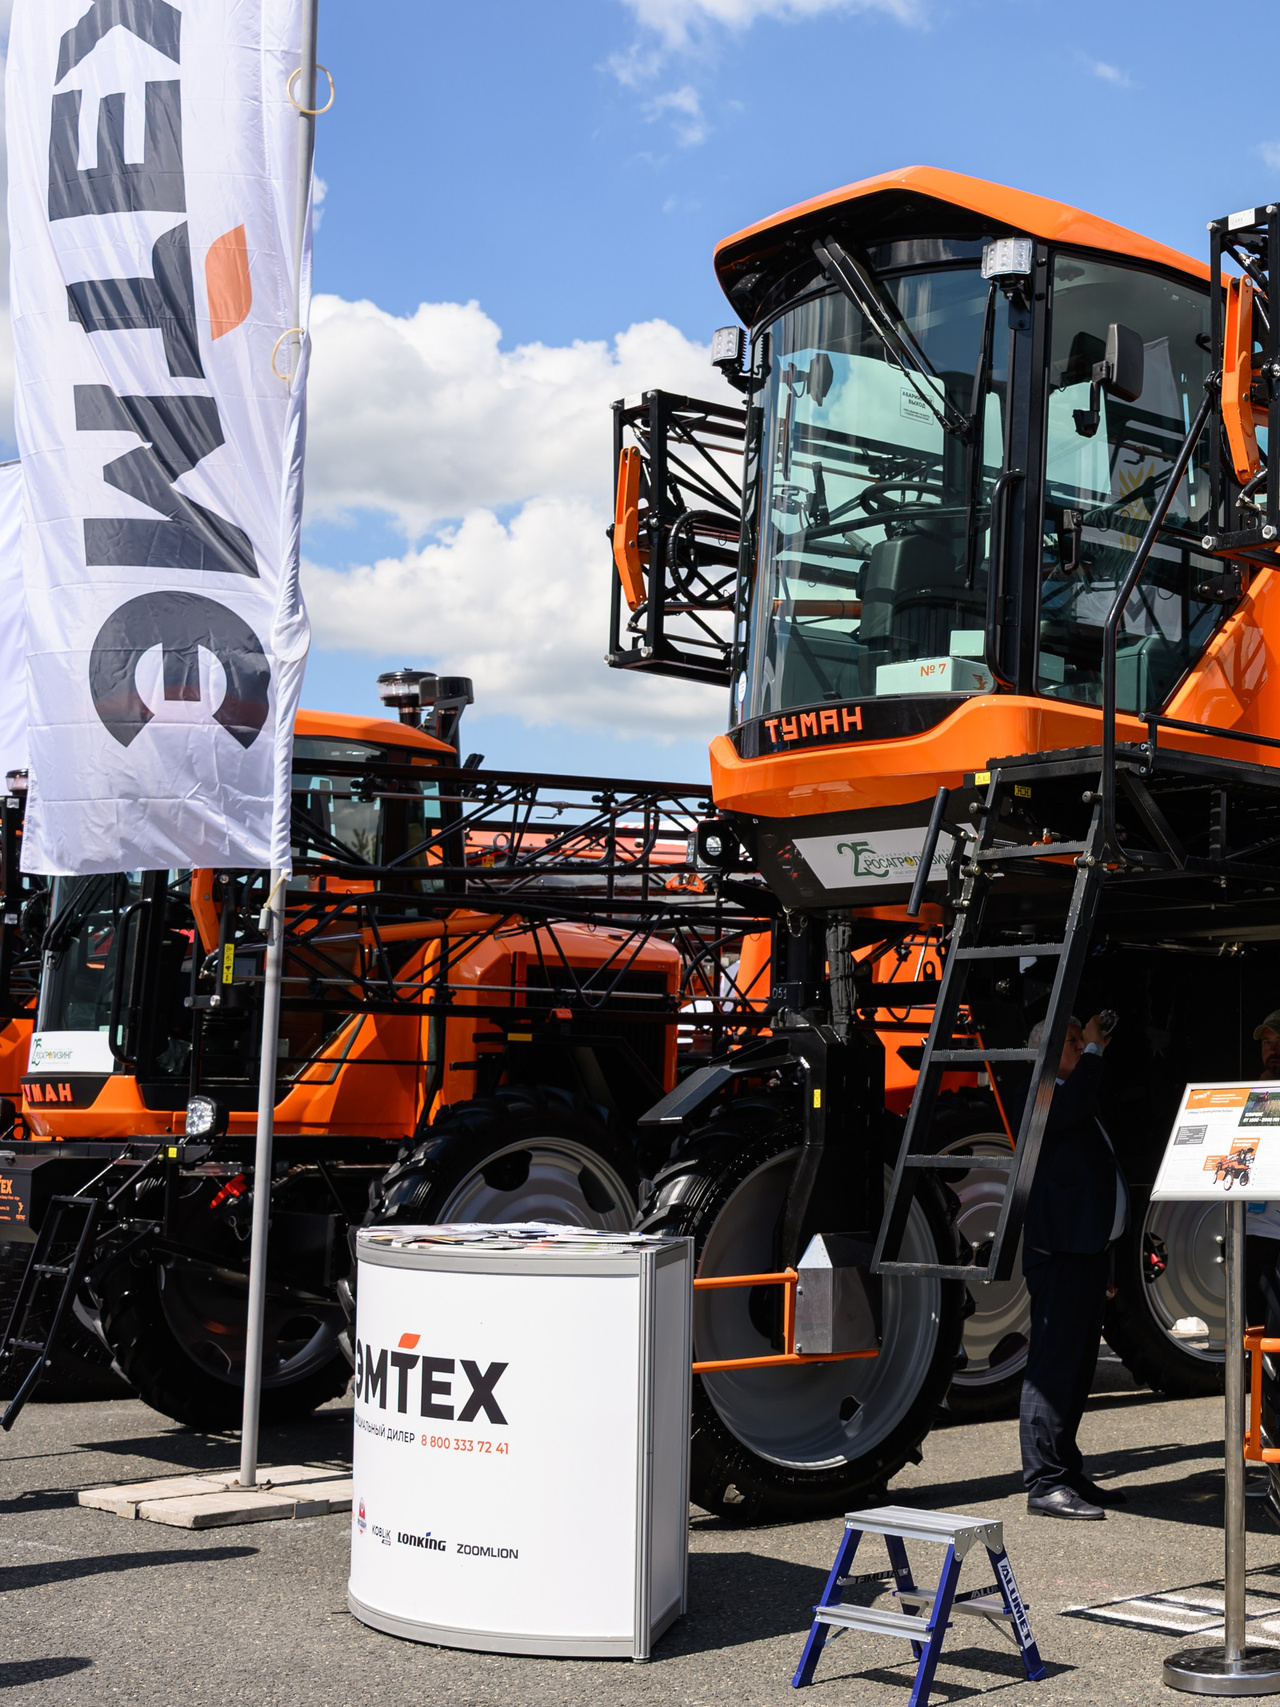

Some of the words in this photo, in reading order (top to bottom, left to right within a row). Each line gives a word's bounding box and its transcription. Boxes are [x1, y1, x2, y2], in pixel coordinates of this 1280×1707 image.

[938, 663, 947, 675] 7
[765, 706, 863, 743] ТУМАН
[356, 1338, 510, 1426] ЭМТЕХ
[386, 1427, 416, 1444] ДИЛЕР
[420, 1434, 428, 1447] 8
[430, 1436, 451, 1449] 800
[453, 1438, 475, 1452] 333
[477, 1441, 492, 1454] 72
[496, 1442, 509, 1455] 41
[456, 1543, 519, 1559] ZOOMLION
[970, 1584, 1000, 1599] ALU
